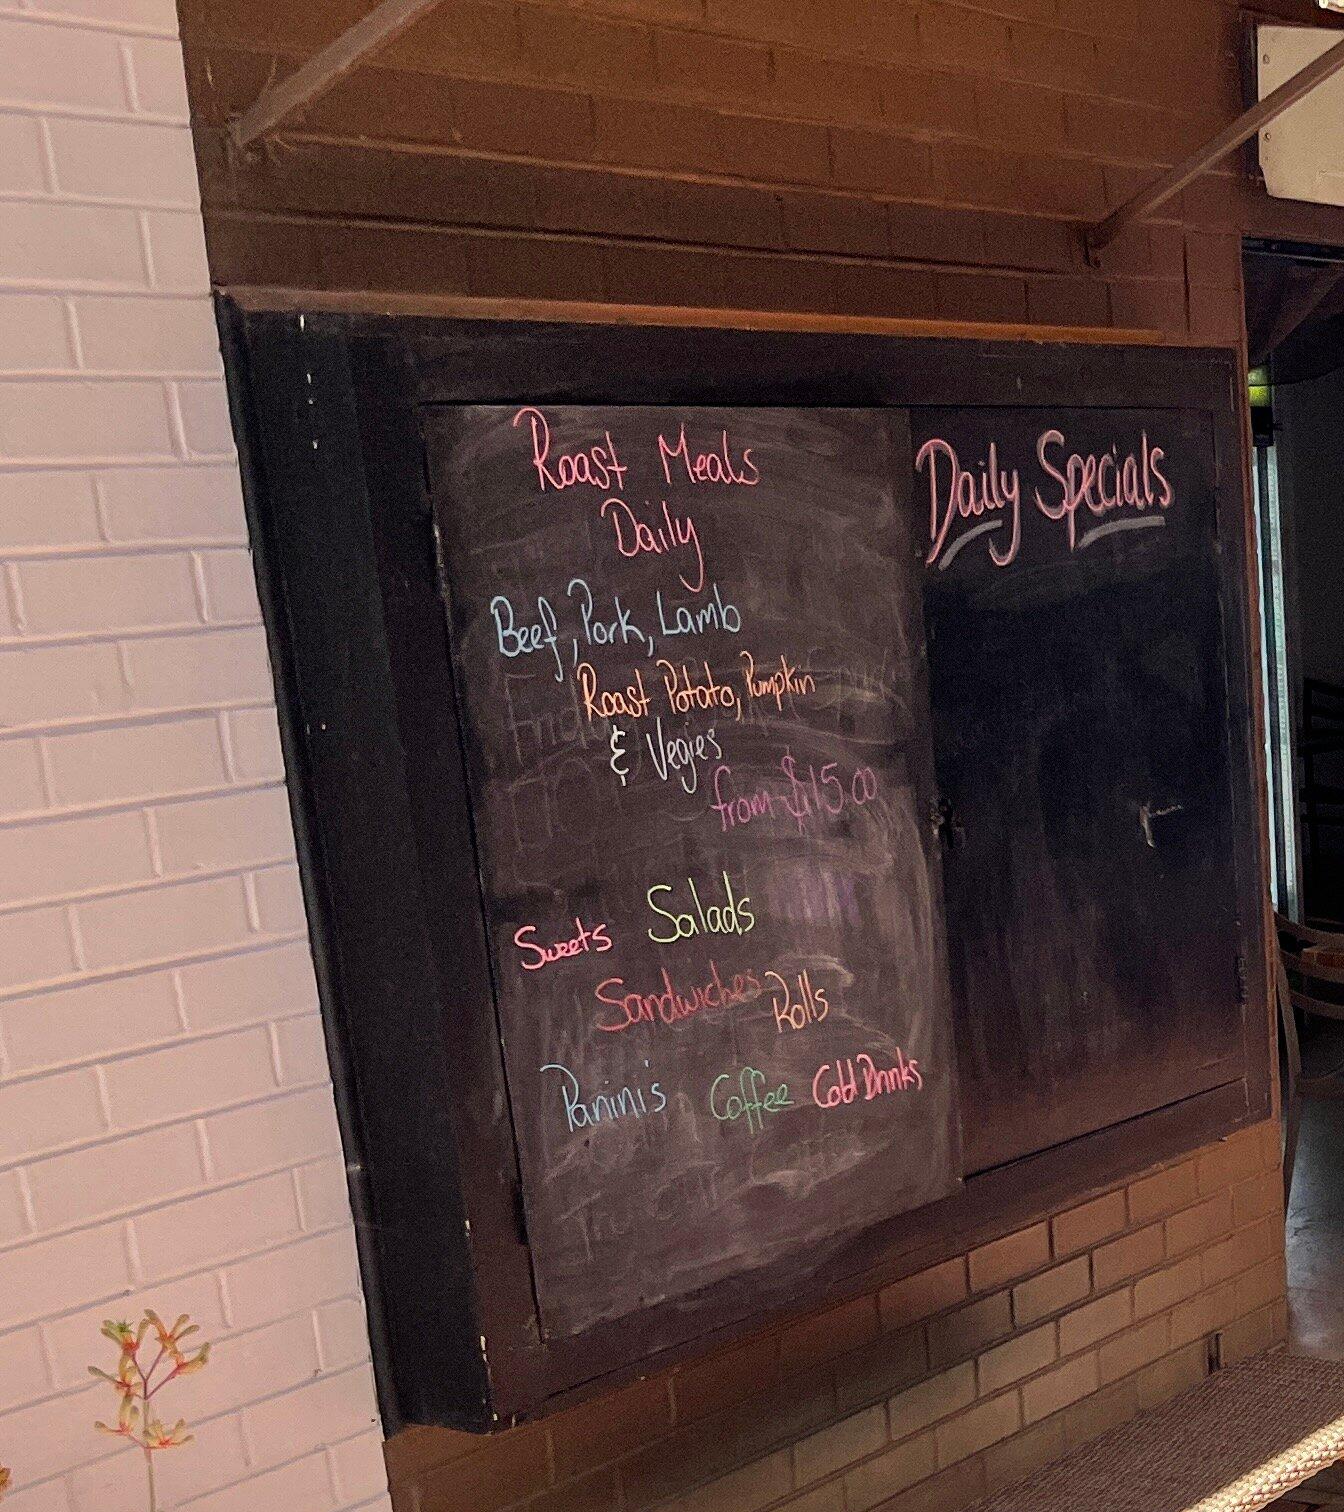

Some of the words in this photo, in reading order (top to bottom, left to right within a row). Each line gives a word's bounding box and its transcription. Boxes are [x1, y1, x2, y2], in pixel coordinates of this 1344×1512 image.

[514, 408, 627, 490] Roast
[659, 424, 761, 486] Meals
[915, 438, 1021, 568] Daily
[1034, 428, 1171, 551] Specials
[601, 498, 704, 592] Daily
[567, 578, 654, 657] Pork,
[656, 582, 742, 634] Lamb
[577, 662, 651, 721] Roast
[656, 659, 741, 721] Potato,
[740, 651, 816, 711] Pumpkin
[610, 724, 630, 787] &
[646, 717, 722, 794] Vegies
[710, 765, 776, 832] from
[514, 917, 613, 970] Sweets
[647, 871, 756, 943] Salads
[595, 960, 762, 1032] Sandwiches
[765, 968, 829, 1034] Rolls
[710, 1066, 795, 1135] Coffee
[812, 1057, 859, 1108] Cold
[856, 1046, 923, 1100] Drinks
